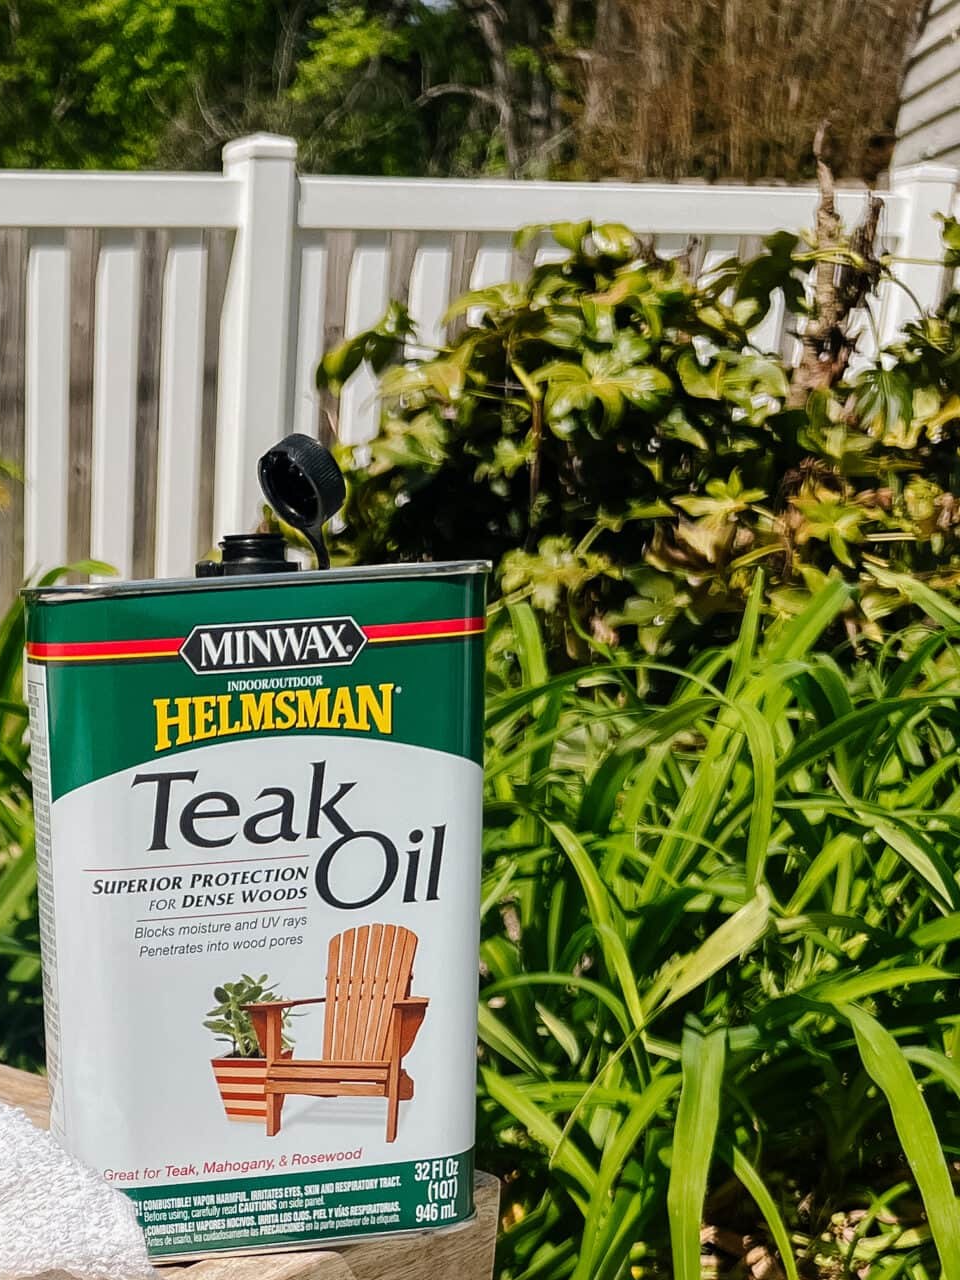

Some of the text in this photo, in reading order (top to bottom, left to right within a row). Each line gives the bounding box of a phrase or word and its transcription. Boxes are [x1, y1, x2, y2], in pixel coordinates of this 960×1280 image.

[200, 624, 347, 666] MINWAX
[227, 675, 323, 692] INDOOR/OUTDOOR
[153, 683, 395, 752] HELMSMAN
[131, 760, 358, 851] Teak
[315, 823, 447, 910] Oil
[92, 866, 309, 895] SUPERIOR PROTECTION
[148, 886, 308, 911] FOR DENSE WOODS
[134, 915, 307, 939] Blocks moisture and UV rays
[139, 935, 303, 958] Penetrates into wood pores
[104, 1148, 363, 1182] Great for Teak, Mahogany, & Rosewood
[414, 1161, 430, 1181] 32
[445, 1158, 459, 1177] Oz
[143, 1197, 192, 1212] COMBUSTIBLE!
[192, 1194, 215, 1207] VAPOR
[250, 1187, 284, 1201] IRRITATES
[284, 1185, 303, 1198] EYES,
[304, 1183, 320, 1196] SKIN
[321, 1182, 334, 1194] AND
[335, 1178, 379, 1193] RESPIRATORY
[427, 1176, 458, 1203] (1QT)
[144, 1210, 168, 1223] Before
[168, 1209, 190, 1221] using,
[191, 1204, 221, 1218] carefully
[222, 1203, 237, 1215] read
[238, 1200, 278, 1213] CAUTIONS
[278, 1200, 288, 1209] on
[289, 1197, 304, 1209] side
[195, 1218, 226, 1232] VAPORES
[280, 1211, 292, 1223] LOS
[312, 1207, 327, 1220] PIEL
[328, 1206, 334, 1218] Y
[415, 1199, 458, 1223] 946 mL
